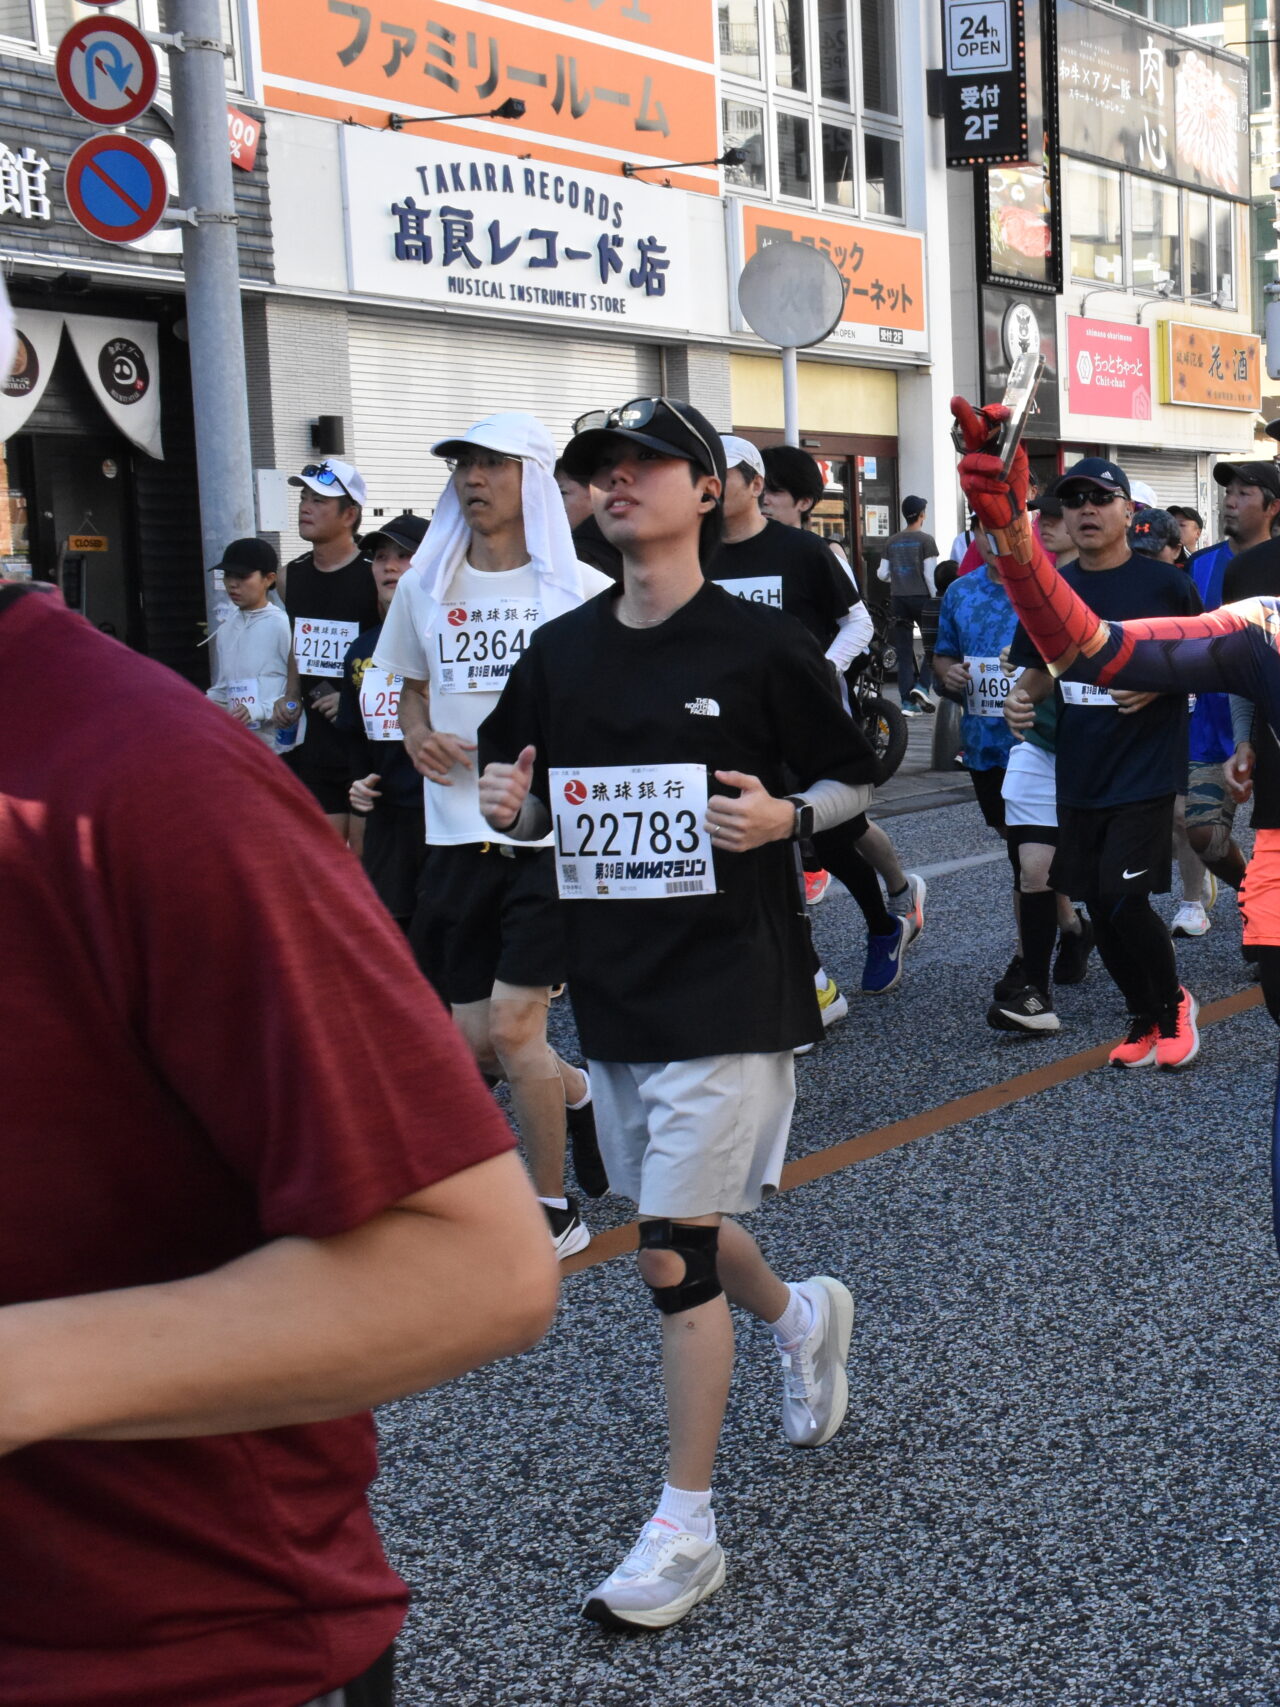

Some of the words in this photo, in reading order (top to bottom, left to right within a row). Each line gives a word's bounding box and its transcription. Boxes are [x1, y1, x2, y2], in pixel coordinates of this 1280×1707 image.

[960, 15, 998, 40] 24h
[957, 40, 1000, 57] OPEN
[328, 1, 670, 138] ファミリールーム
[960, 84, 1000, 110] 受付
[964, 114, 999, 141] 2F
[416, 162, 514, 196] TAKARA
[524, 167, 624, 229] RECORDS
[448, 276, 506, 300] MUSICAL
[509, 284, 586, 309] INSTRUMENT
[591, 295, 626, 314] STORE
[1094, 352, 1143, 377] ちっとちゃっと
[1208, 344, 1249, 382] 花酒
[75, 538, 104, 549] CLOSED
[471, 608, 540, 624] 琉球銀行
[313, 625, 350, 637] 琉球銀行
[979, 677, 1018, 698] 469
[592, 779, 685, 801] 琉球銀行
[557, 810, 700, 857] L22783
[594, 862, 624, 880] 第39回
[625, 859, 706, 880] NAHAマラソン
